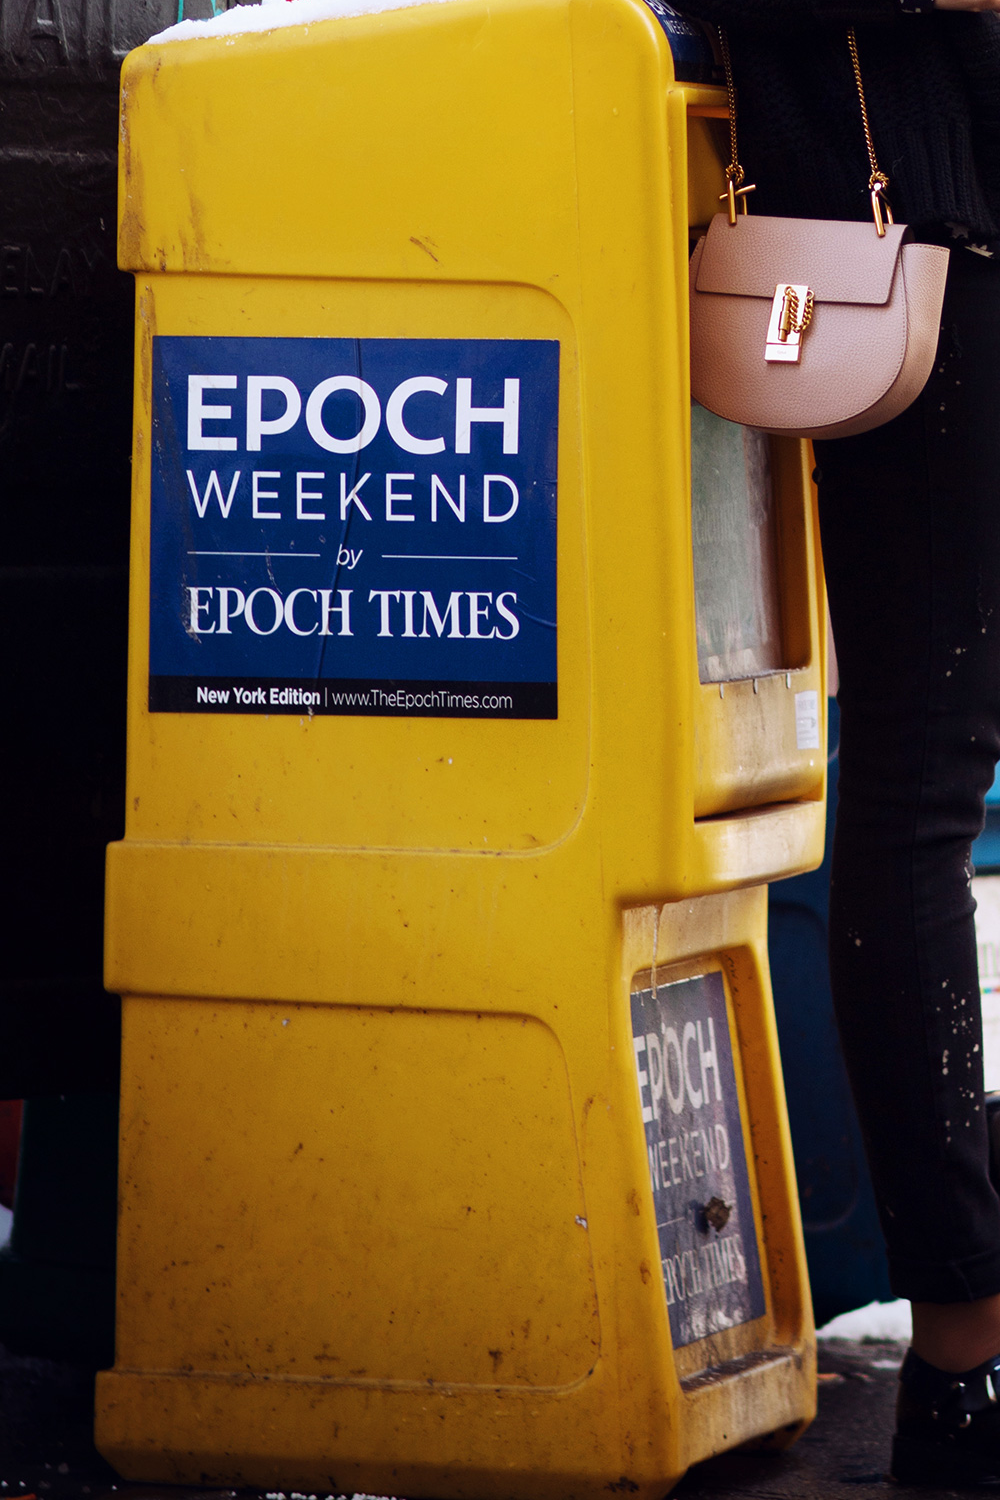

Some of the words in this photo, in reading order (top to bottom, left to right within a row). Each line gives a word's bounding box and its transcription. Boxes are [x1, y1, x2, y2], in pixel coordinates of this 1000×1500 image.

[186, 374, 520, 455] EPOCH
[186, 469, 520, 523] WEEKEND
[336, 544, 363, 570] by
[187, 586, 354, 637] EPOCH
[368, 589, 520, 640] TIMES
[196, 686, 231, 704] New
[232, 687, 267, 705] York
[269, 687, 321, 706] Edition
[332, 689, 513, 710] www.TheEpochTimes.com
[633, 1016, 723, 1124] EPOCH
[661, 1248, 704, 1306] POCH
